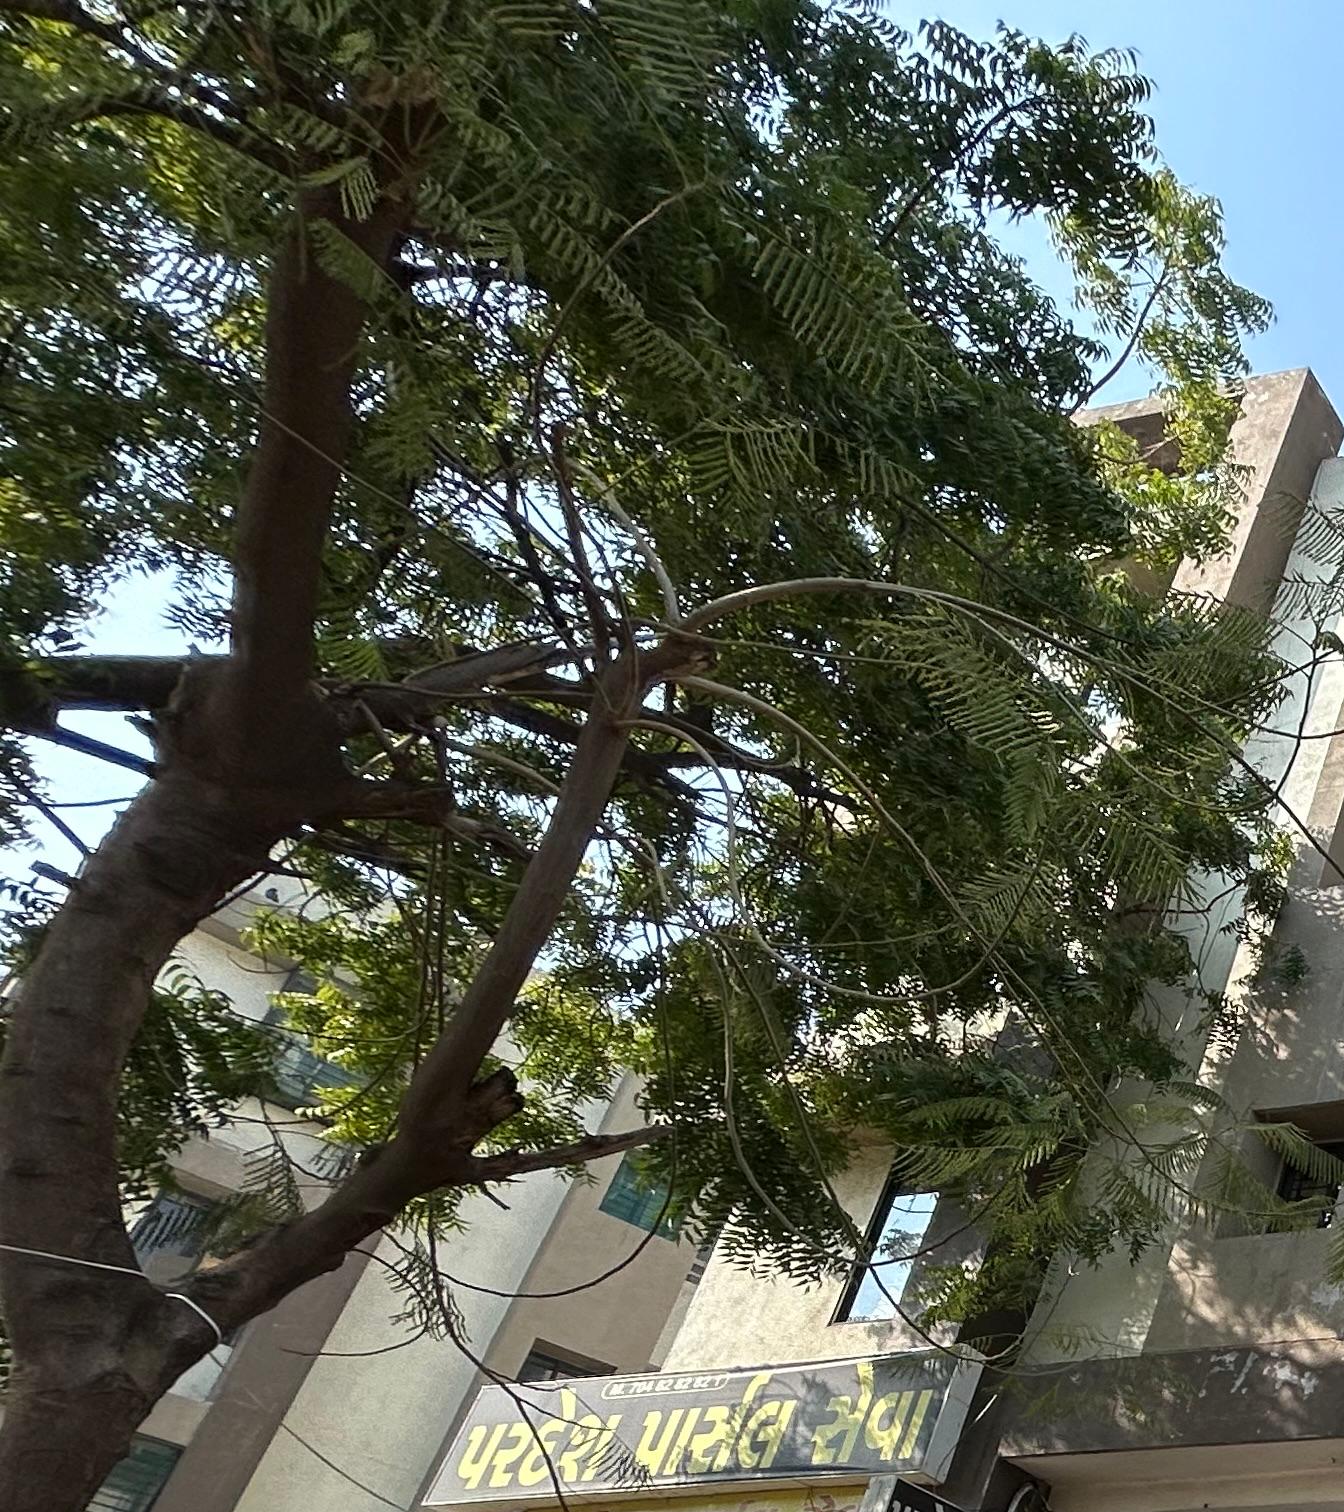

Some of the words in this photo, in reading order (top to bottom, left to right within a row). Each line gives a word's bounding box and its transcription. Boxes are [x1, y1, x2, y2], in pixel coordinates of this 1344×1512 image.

[458, 1387, 622, 1489] પરદેશ
[633, 1373, 797, 1477] પાર્સલ
[811, 1362, 933, 1465] સેવા
